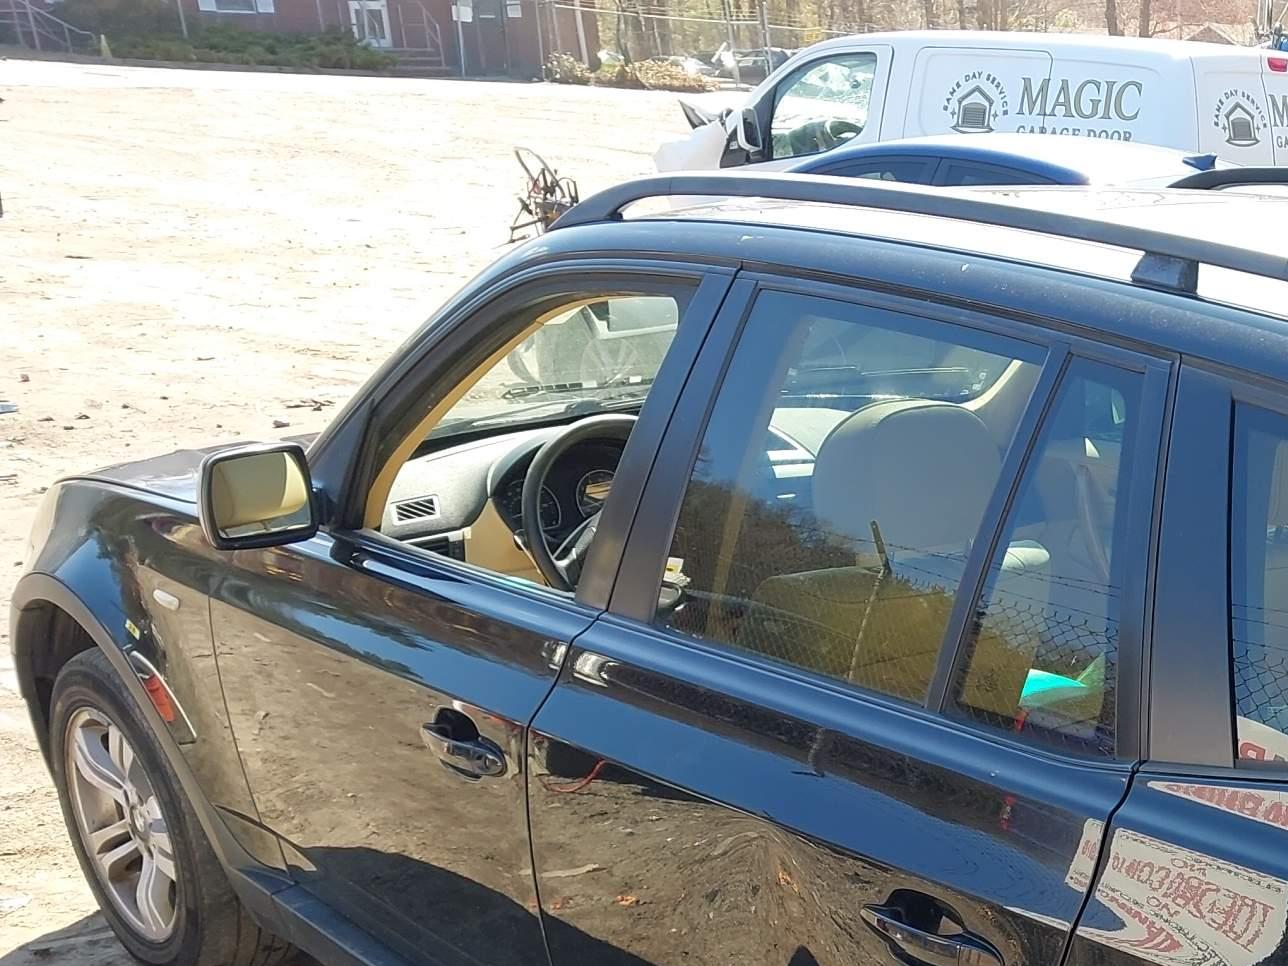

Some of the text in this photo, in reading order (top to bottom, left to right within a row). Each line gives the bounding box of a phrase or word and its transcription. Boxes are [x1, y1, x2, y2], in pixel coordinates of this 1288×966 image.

[964, 70, 984, 83] DAY
[985, 73, 1009, 117] SERVICE
[1015, 76, 1144, 121] MAGIC
[1224, 89, 1239, 101] DAY
[1086, 129, 1132, 142] DOOR
